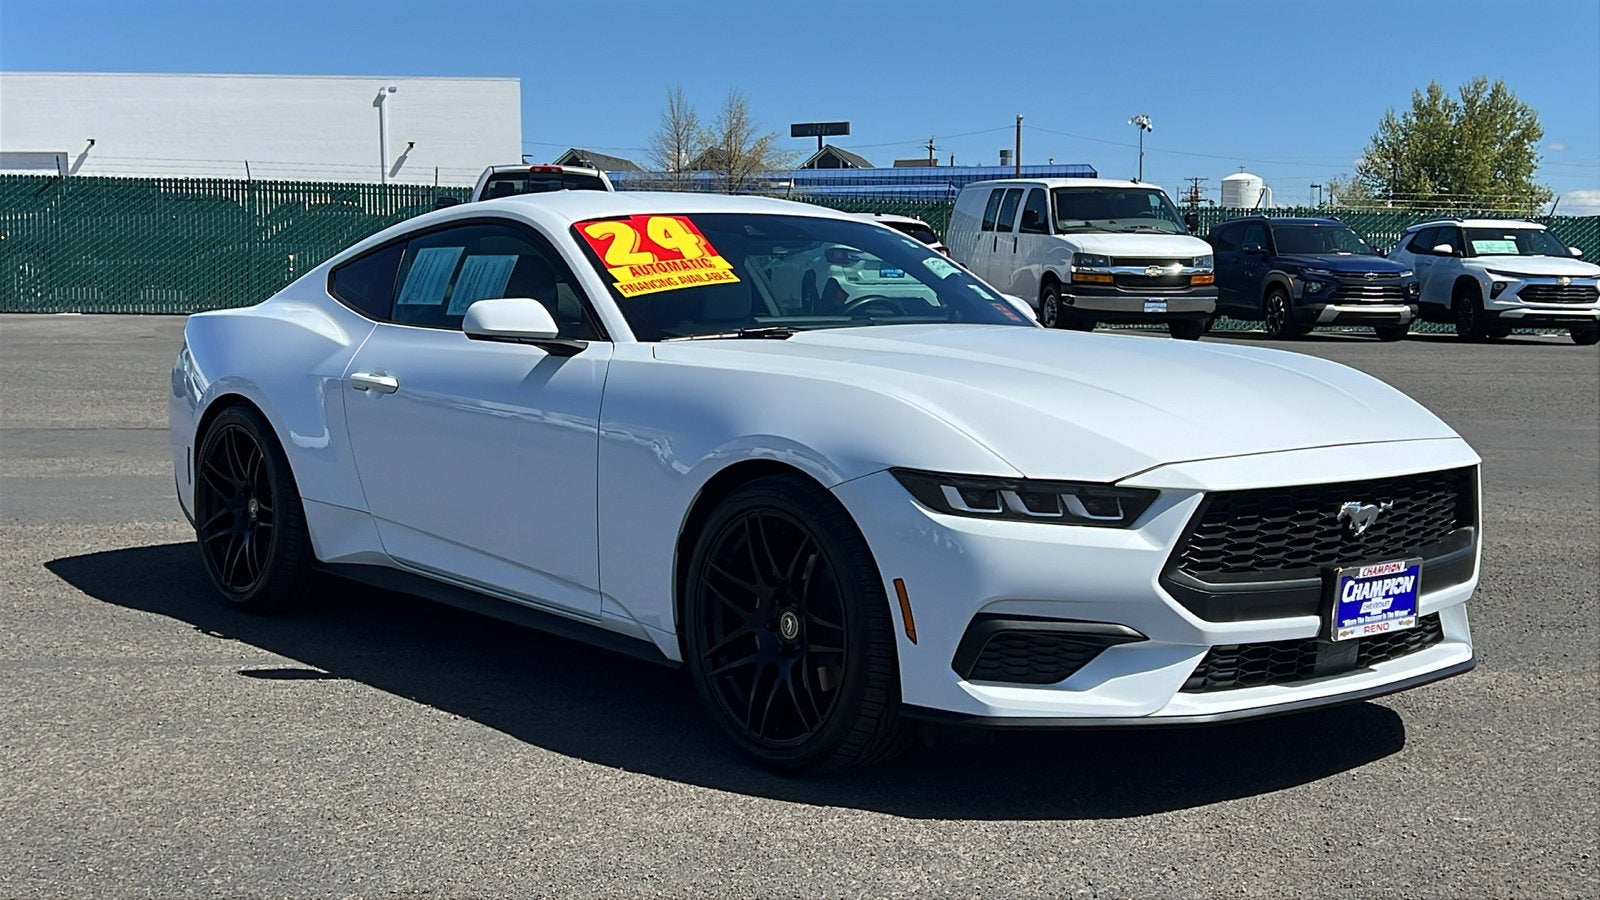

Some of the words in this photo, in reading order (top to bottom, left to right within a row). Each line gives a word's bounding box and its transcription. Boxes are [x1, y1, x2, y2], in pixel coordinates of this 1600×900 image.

[584, 216, 704, 266] 24
[629, 257, 713, 278] AUTOMATIC
[619, 279, 677, 295] FINANCING
[679, 271, 735, 285] AVAILABLE
[1362, 562, 1402, 577] CHAMPION
[1342, 575, 1415, 604] CHAMPION
[1363, 600, 1391, 611] CHEVROLET
[1363, 622, 1390, 635] RENO
